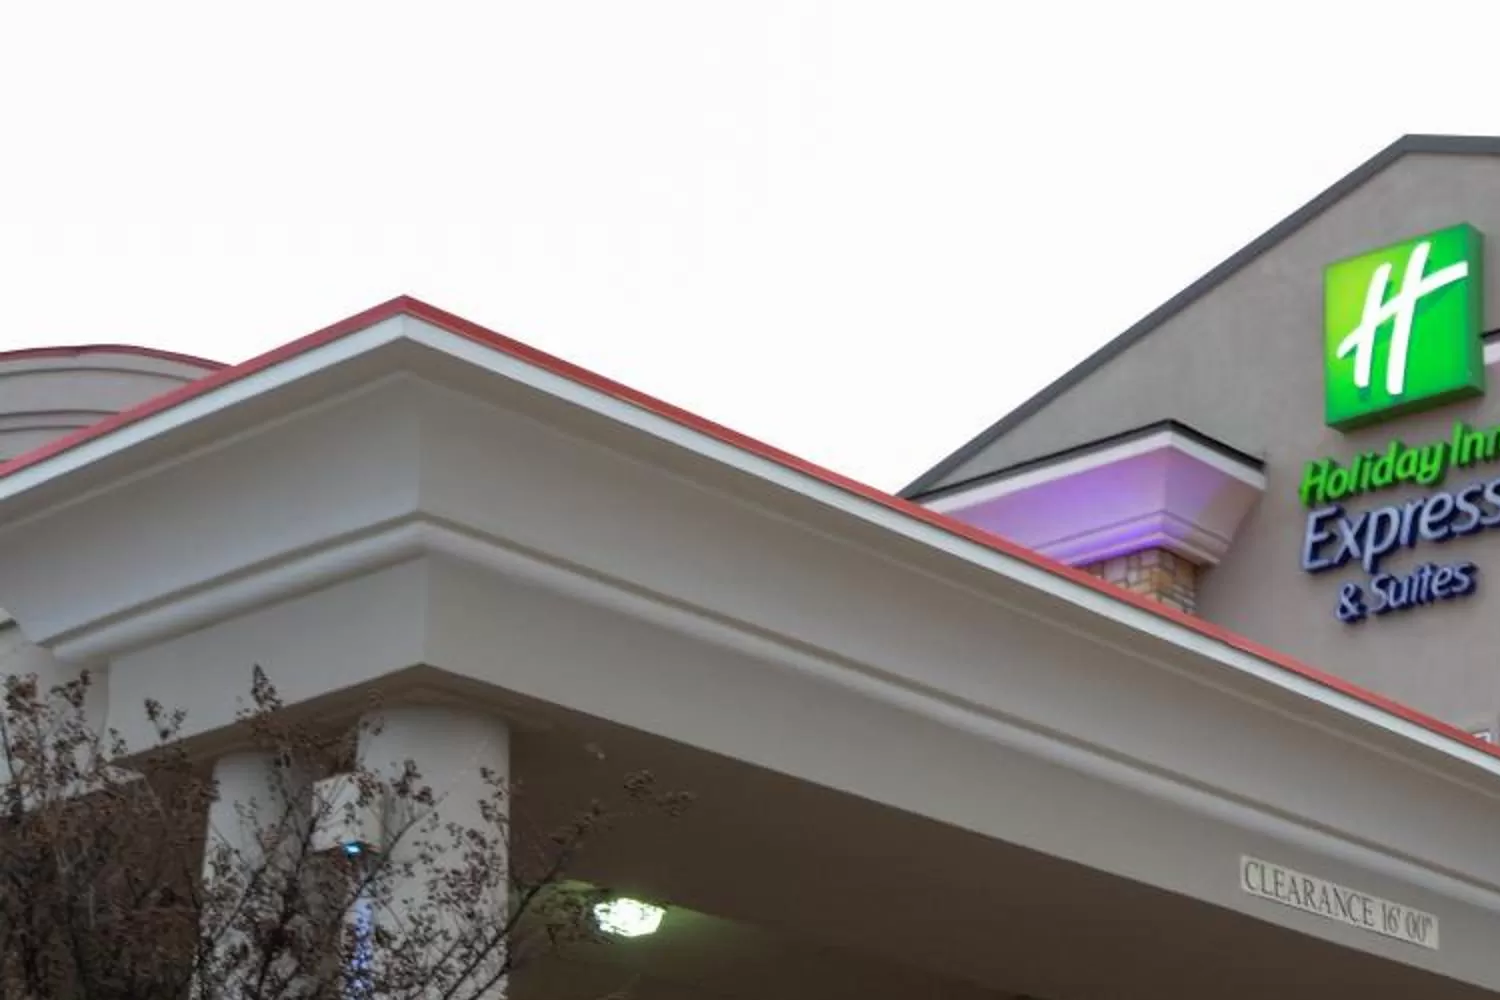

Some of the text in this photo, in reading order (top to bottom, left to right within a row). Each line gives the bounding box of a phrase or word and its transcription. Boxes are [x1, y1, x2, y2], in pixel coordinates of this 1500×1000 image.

[1338, 241, 1468, 395] H
[1301, 442, 1449, 503] Holiday
[1335, 561, 1478, 625] & Suites
[1244, 861, 1376, 927] CLEARANCE
